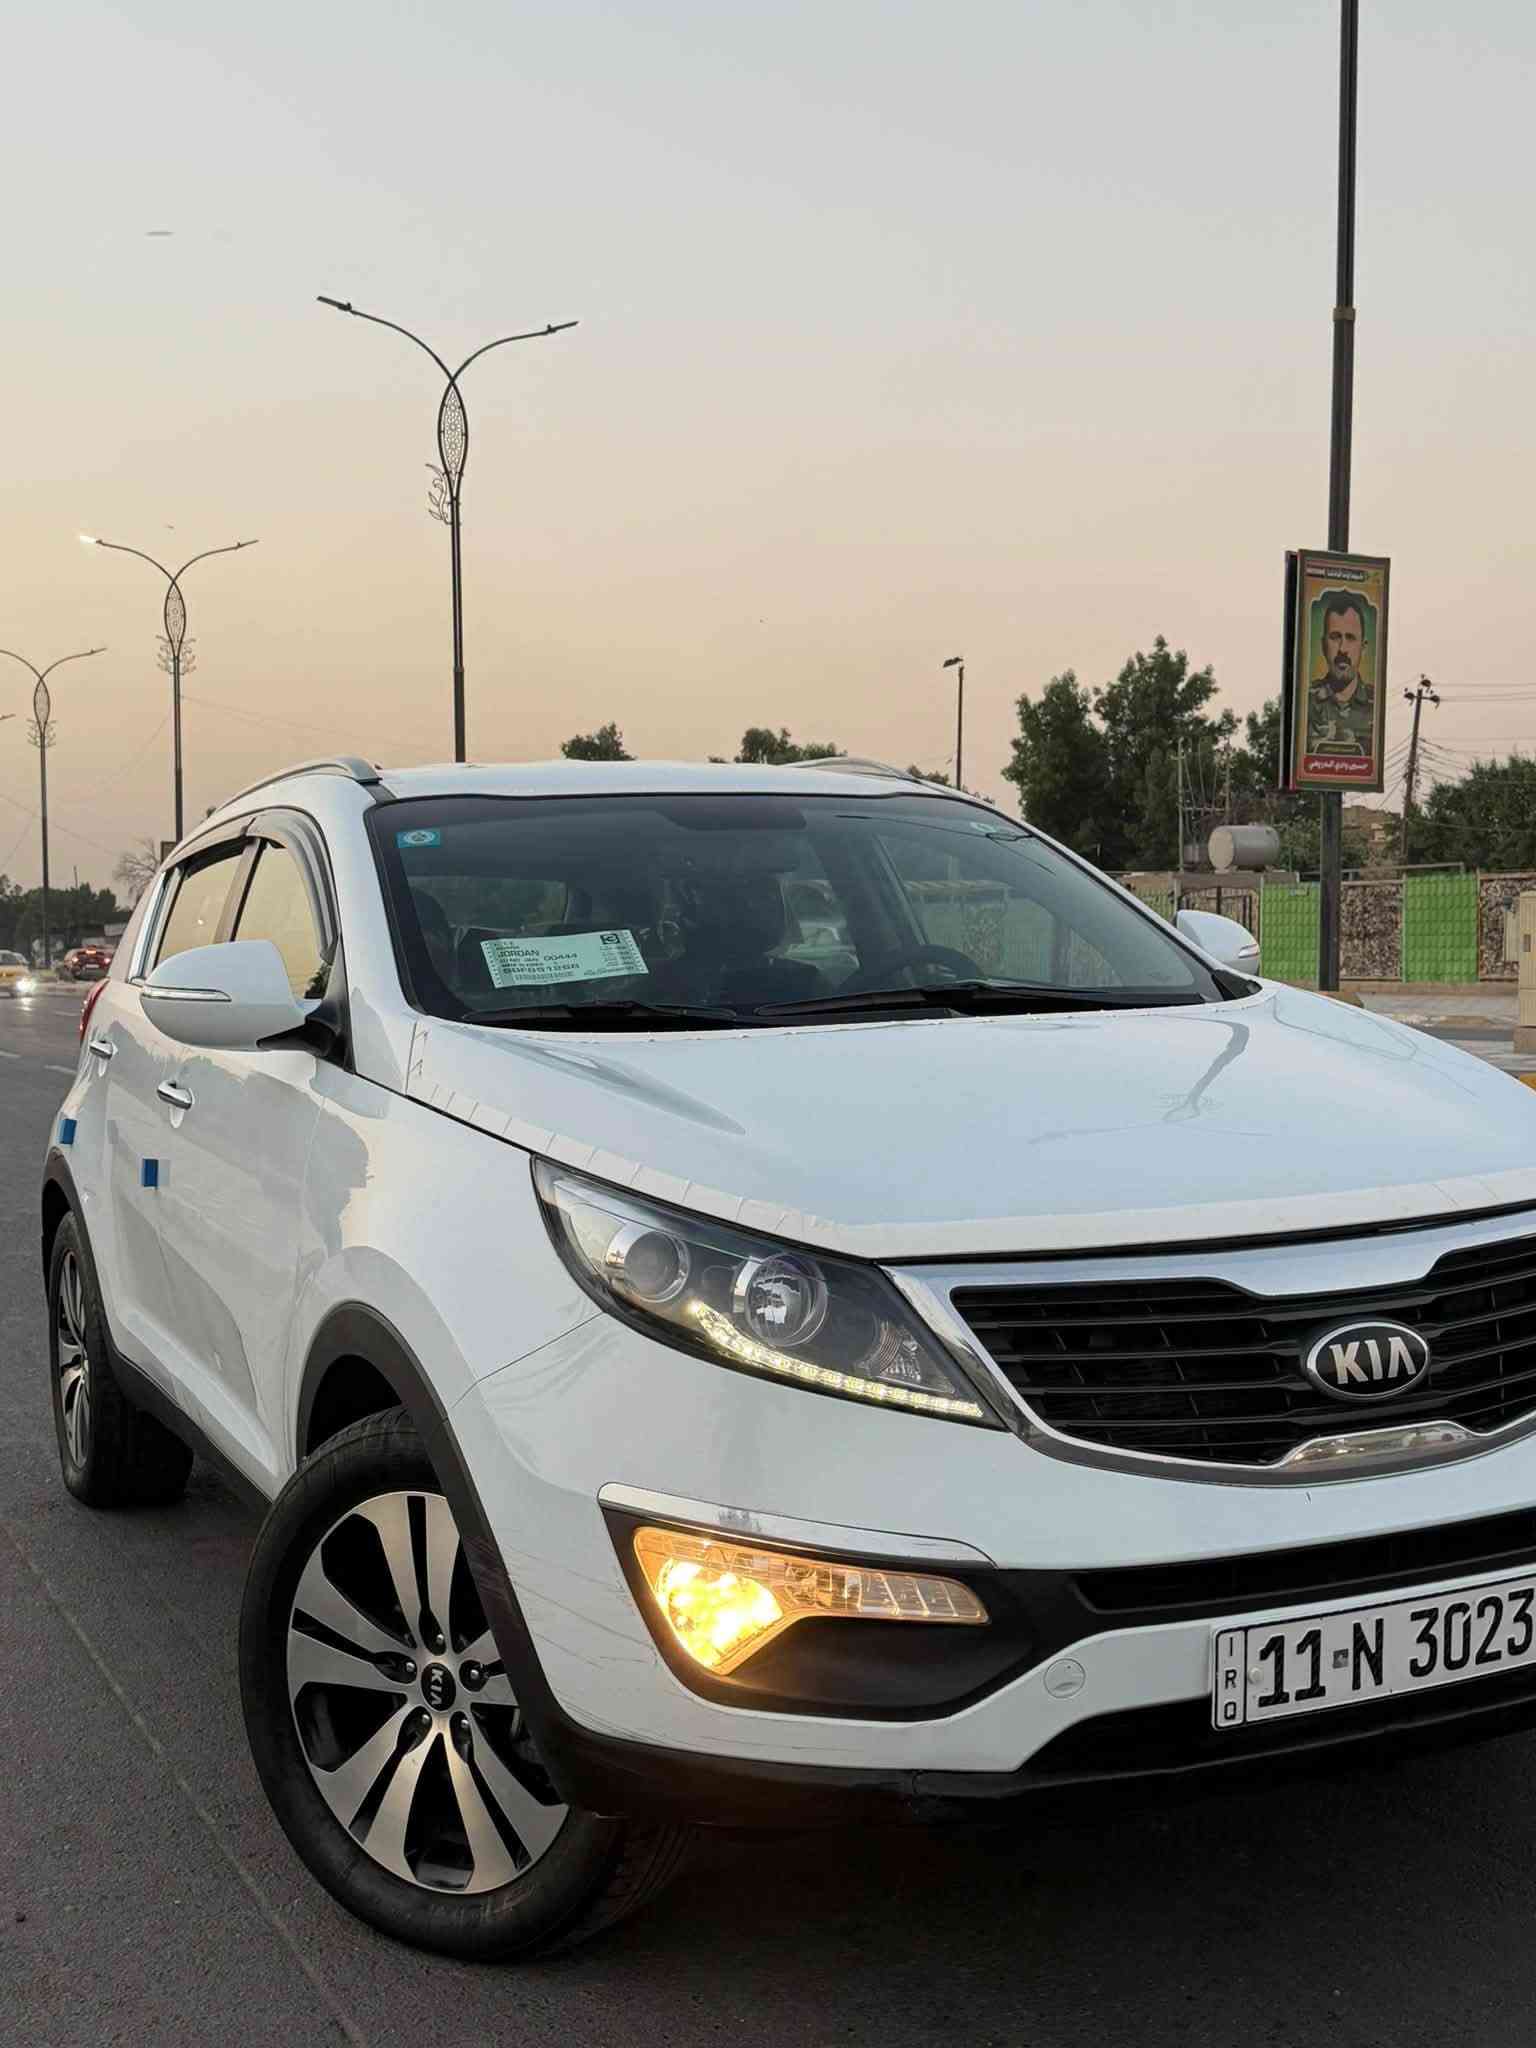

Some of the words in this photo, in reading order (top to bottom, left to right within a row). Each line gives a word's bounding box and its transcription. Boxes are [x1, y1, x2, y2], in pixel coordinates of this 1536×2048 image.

[1329, 1337, 1416, 1385] KIA
[1258, 1629, 1326, 1708] 11
[1352, 1618, 1384, 1691] N
[1409, 1588, 1536, 1678] 3023
[430, 1668, 444, 1705] KIA
